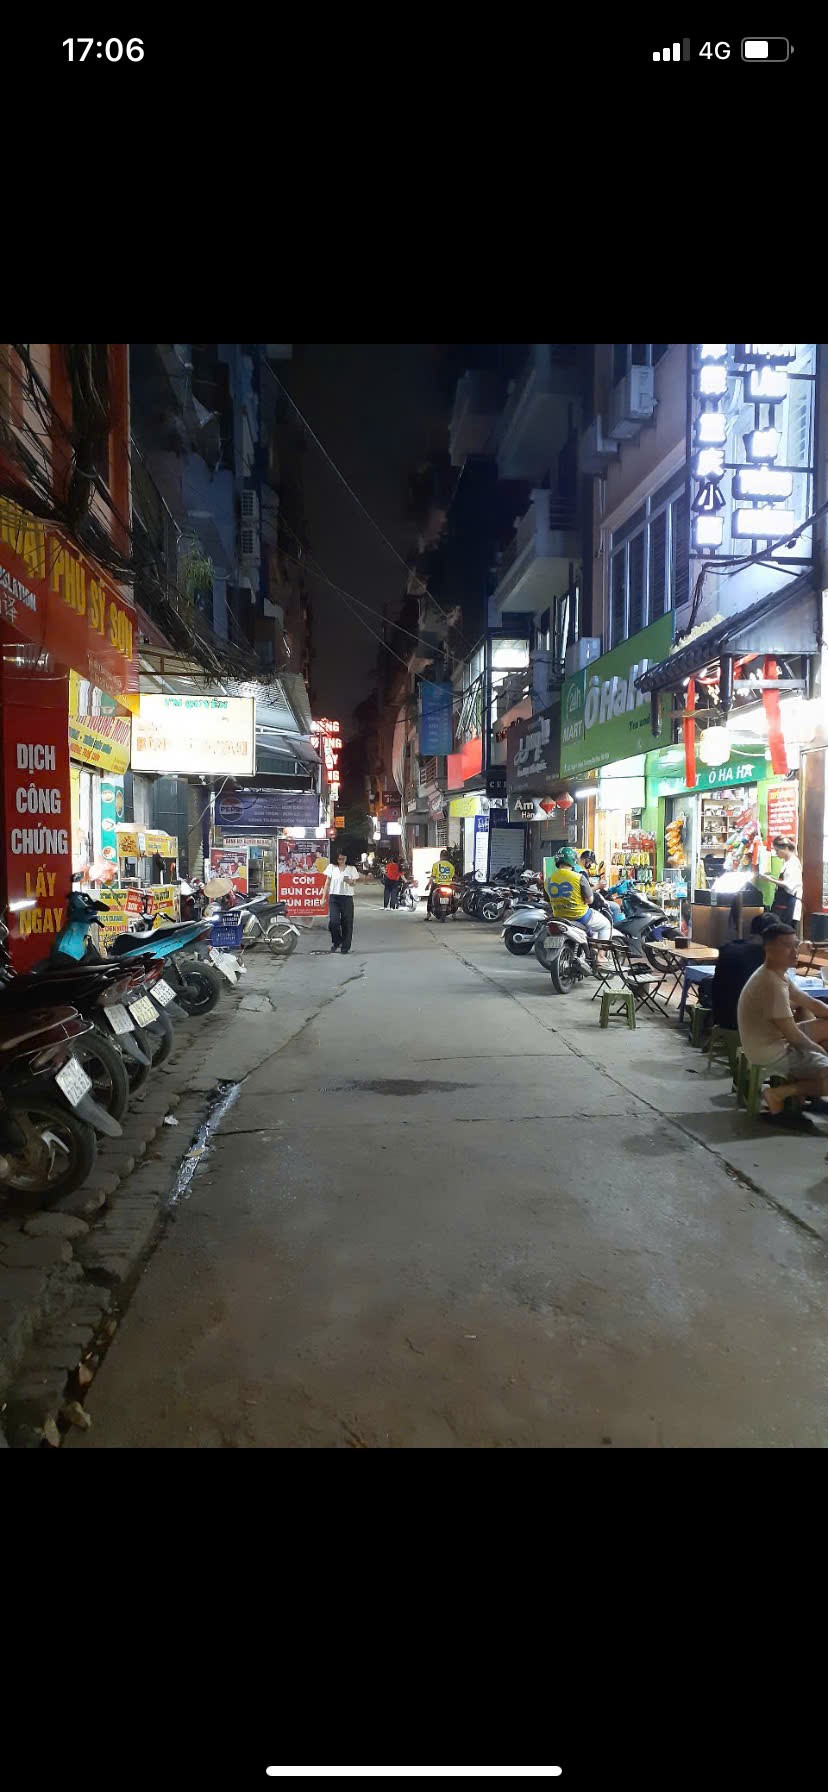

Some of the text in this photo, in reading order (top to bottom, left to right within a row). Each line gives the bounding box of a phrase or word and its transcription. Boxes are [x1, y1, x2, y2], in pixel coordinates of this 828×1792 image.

[16, 743, 56, 775] DỊCH
[718, 768, 733, 782] HA
[15, 782, 61, 814] CÔNG
[11, 822, 68, 855] CHỨNG
[25, 863, 57, 897] LẤY
[280, 886, 303, 896] BÚN
[292, 876, 315, 885] CƠM
[547, 877, 573, 898] be
[18, 908, 63, 936] NGAY
